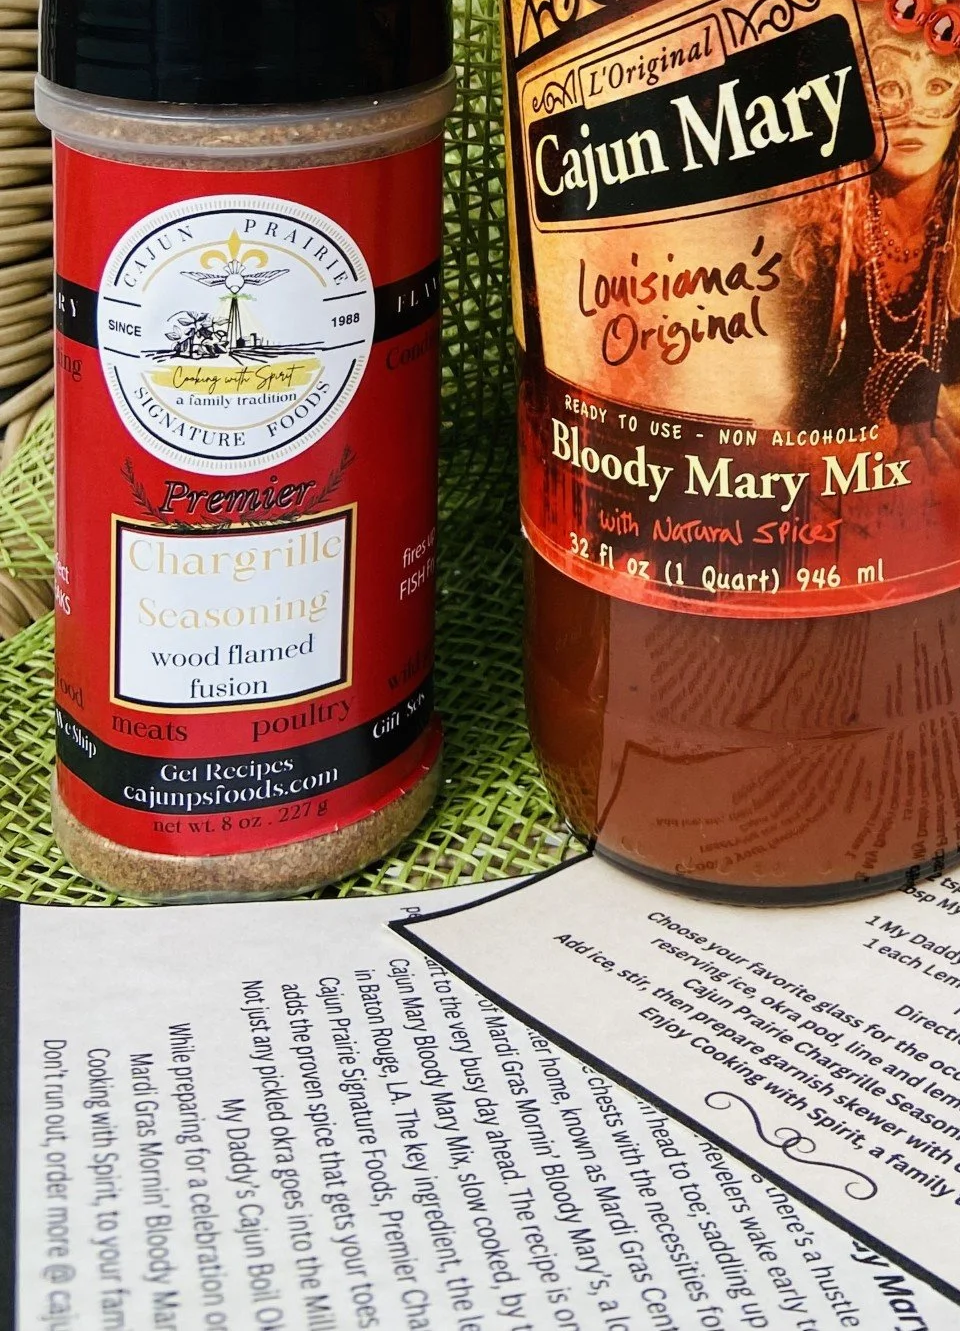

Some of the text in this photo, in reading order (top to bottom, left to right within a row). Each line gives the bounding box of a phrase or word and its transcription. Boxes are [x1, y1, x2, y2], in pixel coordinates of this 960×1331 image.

[588, 27, 717, 99] L'Original
[536, 65, 853, 210] Cajun Mary
[124, 218, 349, 288] CAJUN PRAIRIE
[578, 235, 783, 318] Louisiana's
[108, 319, 142, 337] SINCE
[331, 313, 360, 328] 1988
[601, 295, 769, 367] Original
[172, 365, 304, 393] Cooking with Spirit
[133, 379, 331, 447] SIGNATURE FOODS
[176, 392, 297, 409] a family tradition
[565, 394, 607, 423] READY
[619, 414, 637, 432] TO
[650, 422, 682, 439] USE
[720, 429, 757, 446] NON
[772, 424, 879, 447] ALCOHOLIC
[552, 417, 911, 513] Bloody Mary Mix
[160, 475, 317, 516] Premier
[599, 510, 639, 536] with
[653, 517, 743, 546] Natural
[128, 531, 343, 583] Chargrille
[403, 540, 425, 568] fires
[570, 532, 884, 594] 32 fl oz (1 Quart) 946 ml
[400, 566, 425, 600] FISH
[137, 588, 330, 630] Seasoning
[151, 634, 315, 668] wood flamed
[190, 677, 269, 701] fusion
[71, 721, 97, 758] Ship
[112, 714, 187, 743] meats
[252, 695, 354, 742] poultry
[372, 711, 399, 739] Gift
[123, 768, 338, 811] cajunpsfoods.com
[161, 758, 293, 782] Get Recipes
[153, 821, 181, 833] net
[189, 819, 215, 833] wt.
[222, 817, 232, 831] 8
[239, 817, 261, 829] oz
[279, 802, 311, 822] 227
[317, 799, 328, 815] g
[43, 1040, 69, 1079] Don't
[44, 1084, 64, 1110] run
[638, 1007, 693, 1039] Enjoy
[690, 1037, 767, 1086] Cooking
[763, 1082, 808, 1111] with
[806, 1108, 866, 1150] Spirit,
[868, 1146, 885, 1159] a
[885, 1154, 955, 1198] family
[40, 1114, 69, 1148] out,
[46, 1152, 72, 1199] order
[83, 1048, 121, 1281] Cooking with Spirit, to your
[130, 1053, 177, 1285] Mardi Gras Mornin' Bloody
[166, 1022, 224, 1305] While preparing for a celebration
[46, 1206, 70, 1258] more
